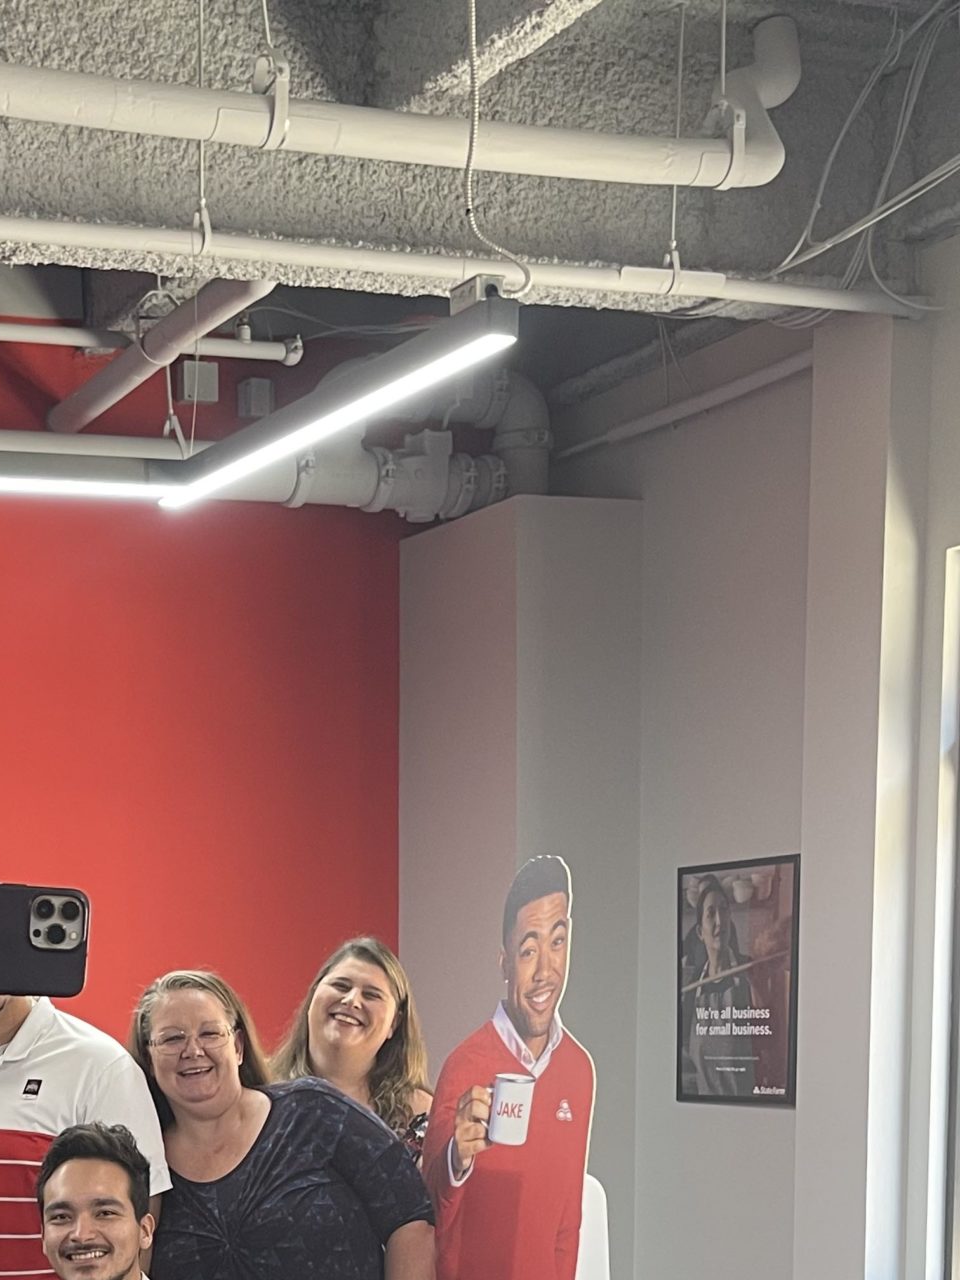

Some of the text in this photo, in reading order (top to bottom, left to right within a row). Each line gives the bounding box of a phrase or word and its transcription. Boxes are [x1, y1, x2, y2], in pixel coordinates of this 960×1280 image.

[696, 1006, 770, 1020] We're all business
[696, 1022, 772, 1035] for small business.
[497, 1101, 524, 1118] JAKE
